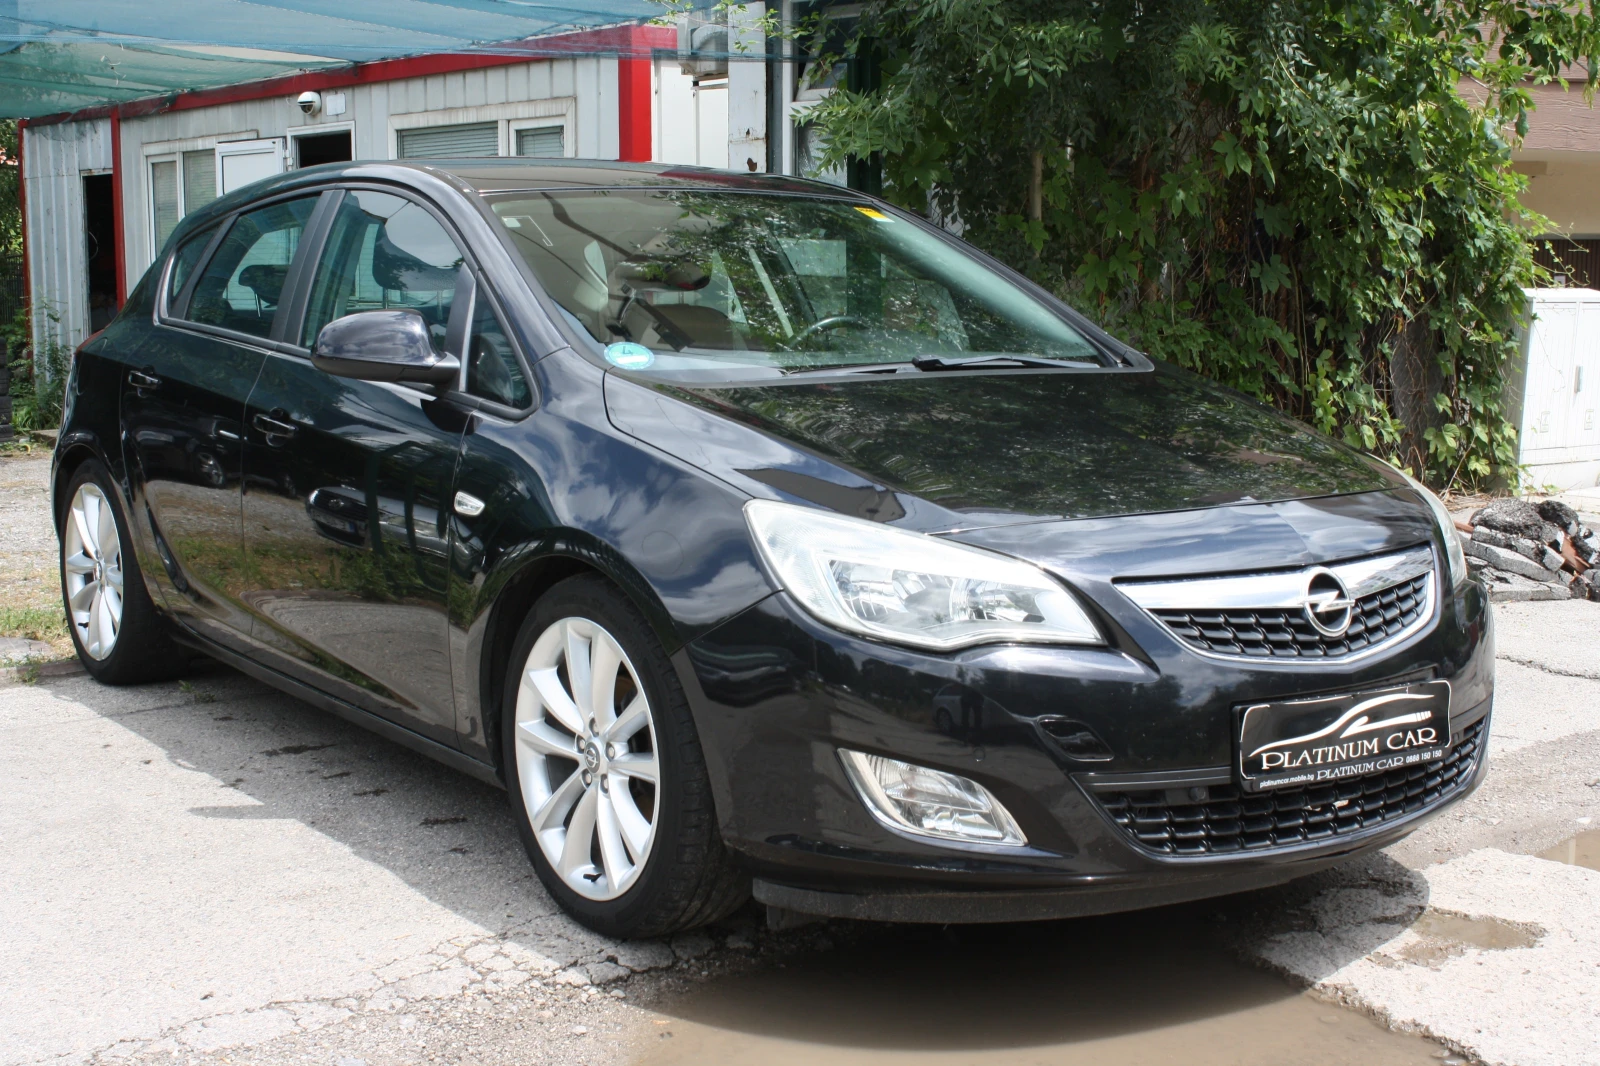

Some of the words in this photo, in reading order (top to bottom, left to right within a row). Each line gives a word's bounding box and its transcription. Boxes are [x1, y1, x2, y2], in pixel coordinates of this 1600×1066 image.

[1261, 738, 1379, 770] PLATINUM
[1386, 728, 1437, 750] CAR
[1259, 774, 1315, 788] platinumcar.mobile.bg
[1316, 762, 1374, 780] PLATINUM
[1376, 757, 1404, 770] CAR
[1421, 752, 1431, 760] 150
